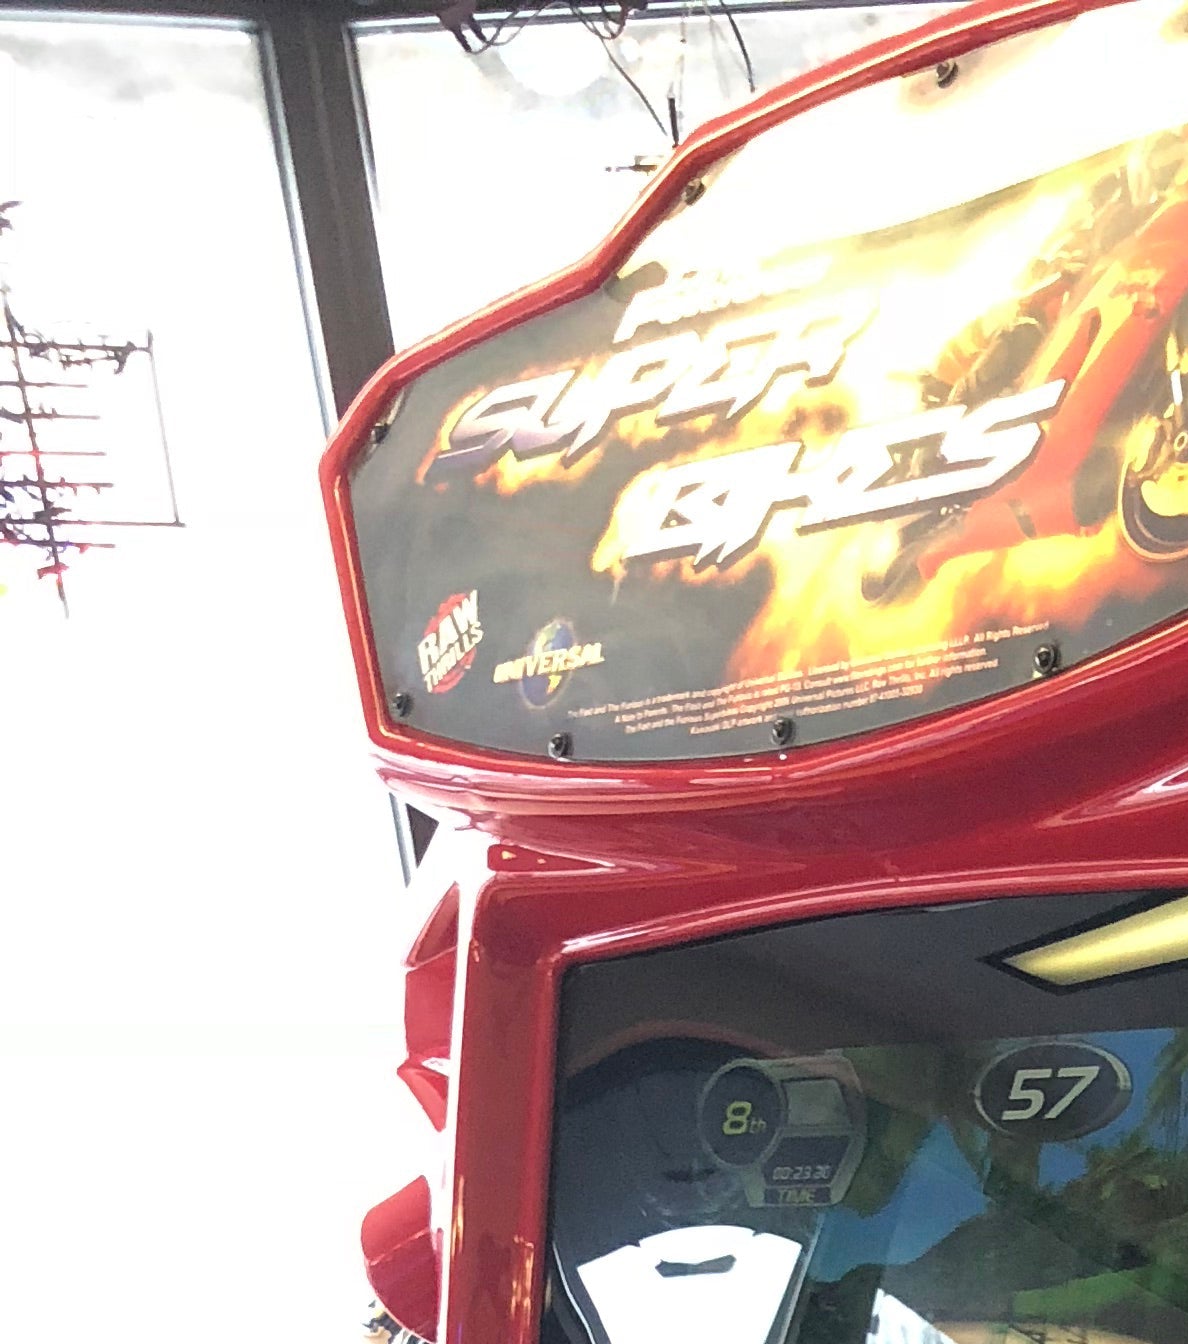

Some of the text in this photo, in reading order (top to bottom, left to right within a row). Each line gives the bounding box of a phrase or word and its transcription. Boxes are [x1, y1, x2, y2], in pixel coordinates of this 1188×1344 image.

[433, 294, 879, 468] SUPER
[620, 379, 1066, 566] BIKES
[417, 589, 478, 675] RAW
[423, 621, 484, 694] THRILLS
[493, 642, 605, 685] UNIVERSAL
[722, 1100, 767, 1135] 8th
[1002, 1066, 1100, 1120] 57
